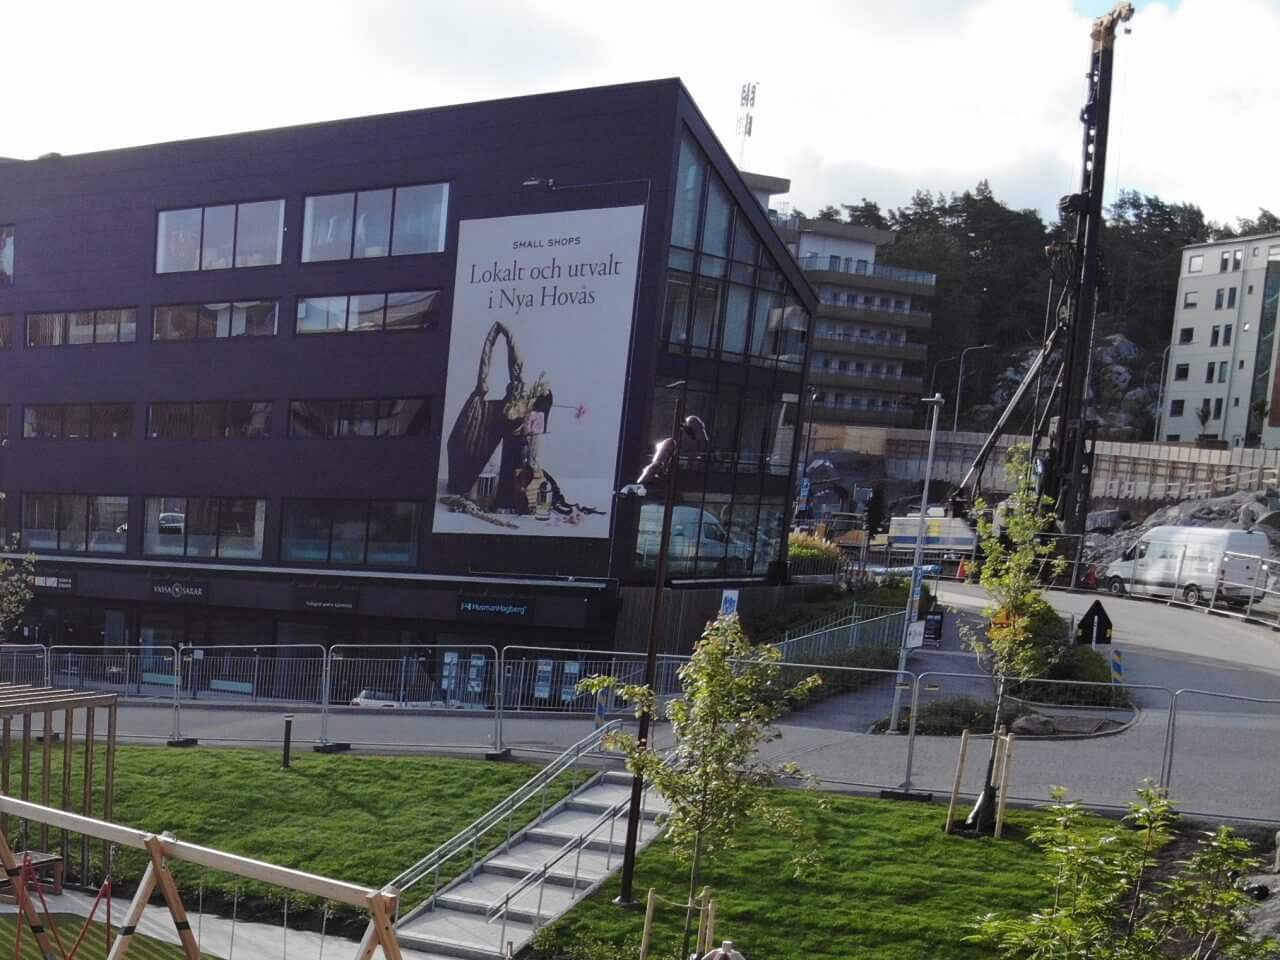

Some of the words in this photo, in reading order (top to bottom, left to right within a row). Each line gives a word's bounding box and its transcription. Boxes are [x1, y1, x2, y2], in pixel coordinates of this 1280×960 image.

[512, 240, 545, 250] SMALL
[547, 236, 581, 247] SHOPS
[470, 259, 526, 284] Lokalt
[529, 257, 561, 281] och
[568, 252, 623, 278] utvalt
[488, 290, 494, 309] i
[498, 287, 534, 316] Nya
[540, 283, 596, 306] Hovås
